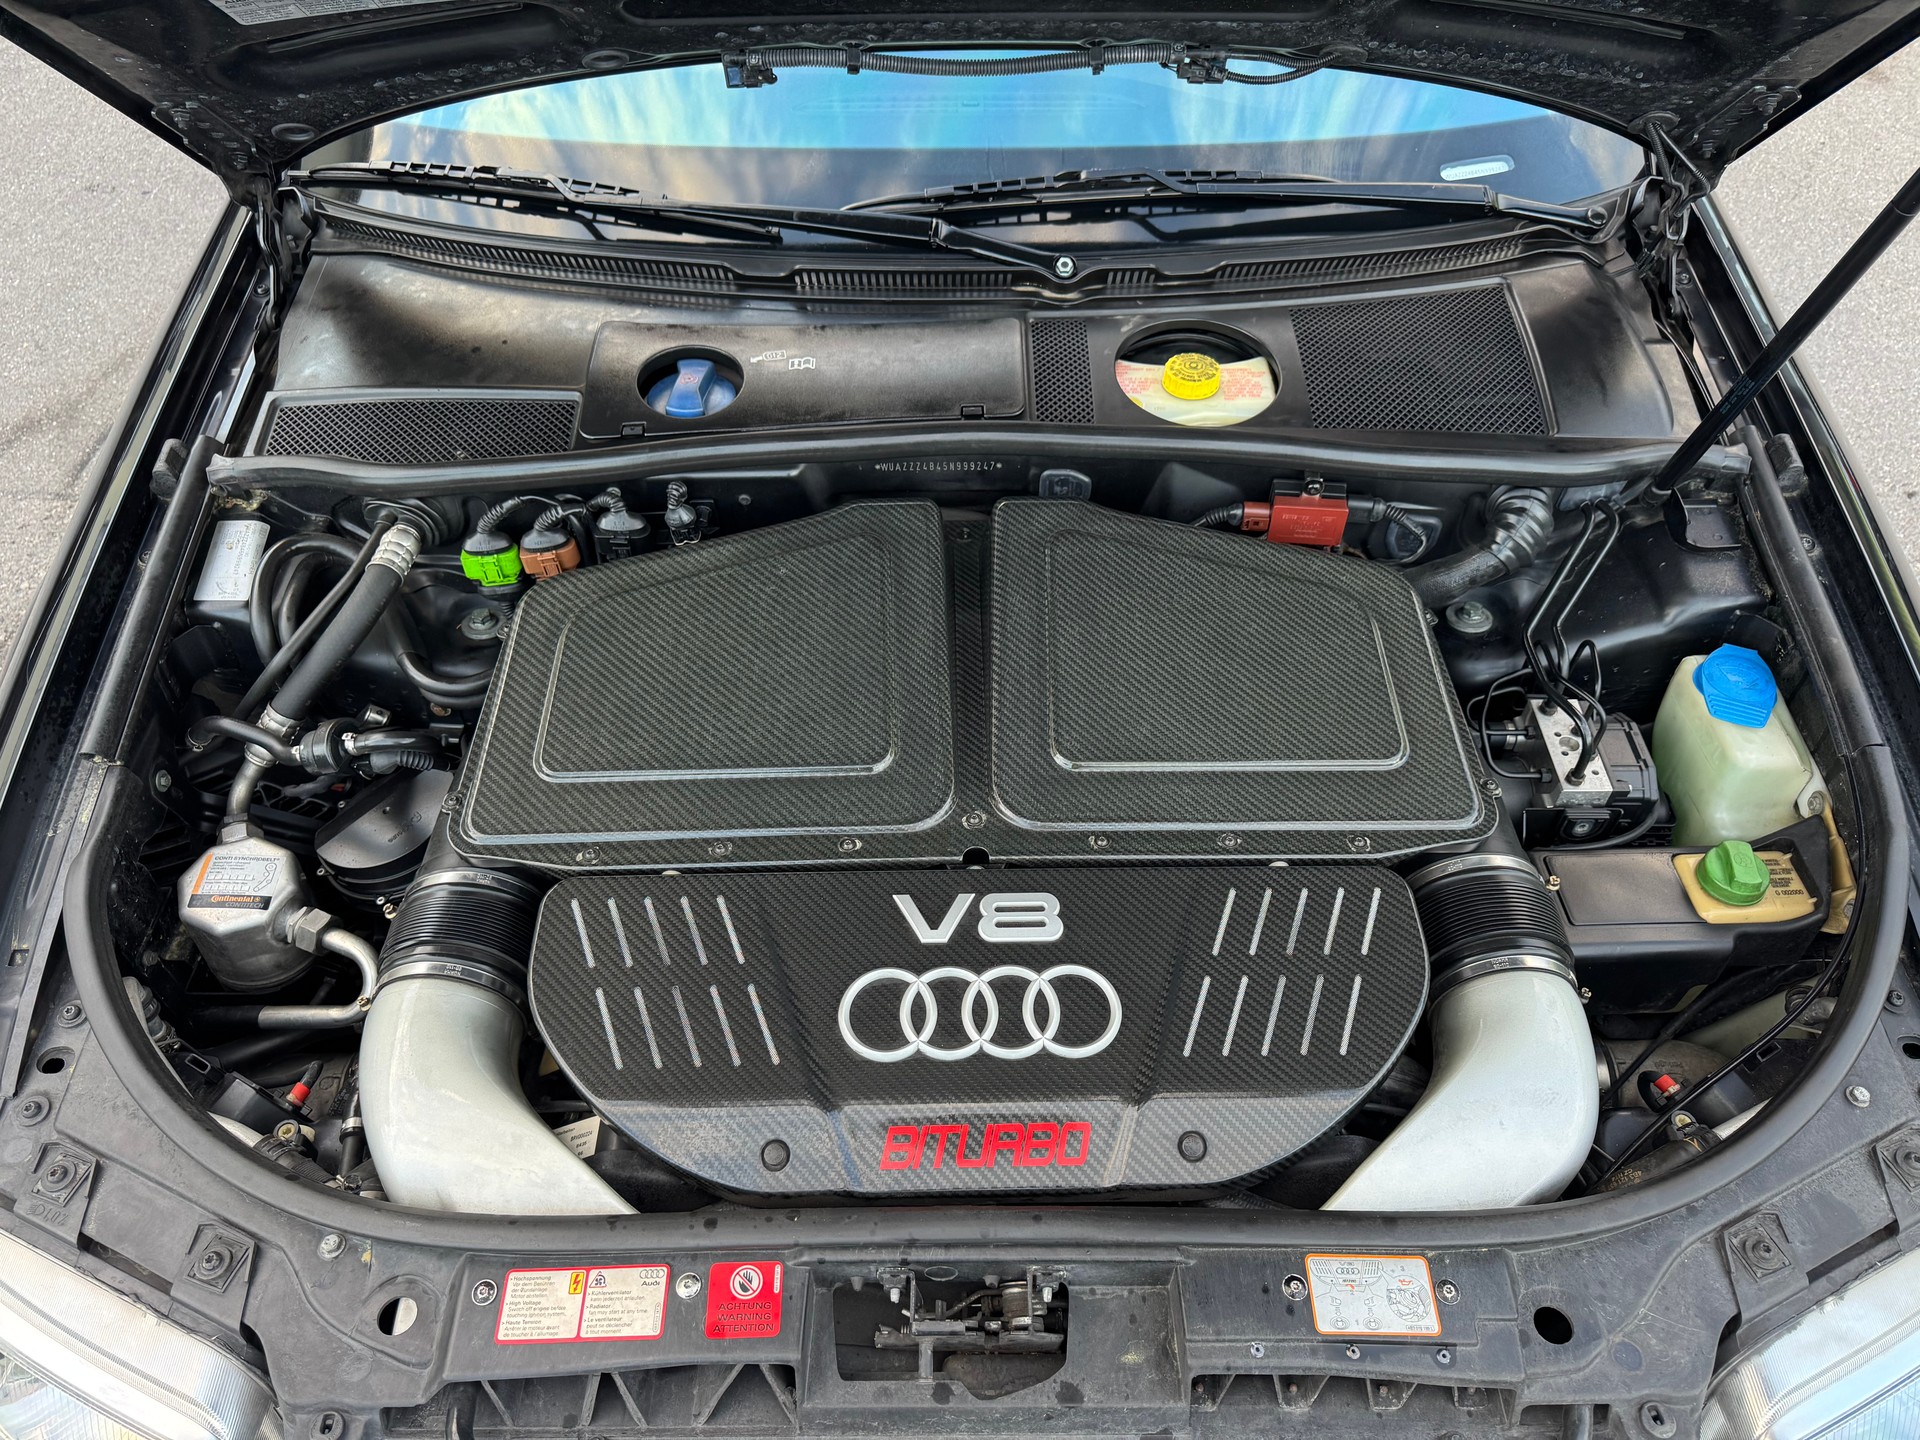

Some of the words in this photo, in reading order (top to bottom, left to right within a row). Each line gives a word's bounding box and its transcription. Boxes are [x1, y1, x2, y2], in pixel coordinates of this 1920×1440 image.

[211, 894, 254, 903] Continental
[892, 892, 1064, 944] V8
[880, 1121, 1092, 1171] BITURBO
[718, 1302, 772, 1311] ACHTUNG
[717, 1313, 772, 1322] WARNING
[713, 1323, 774, 1333] ATTENTION
